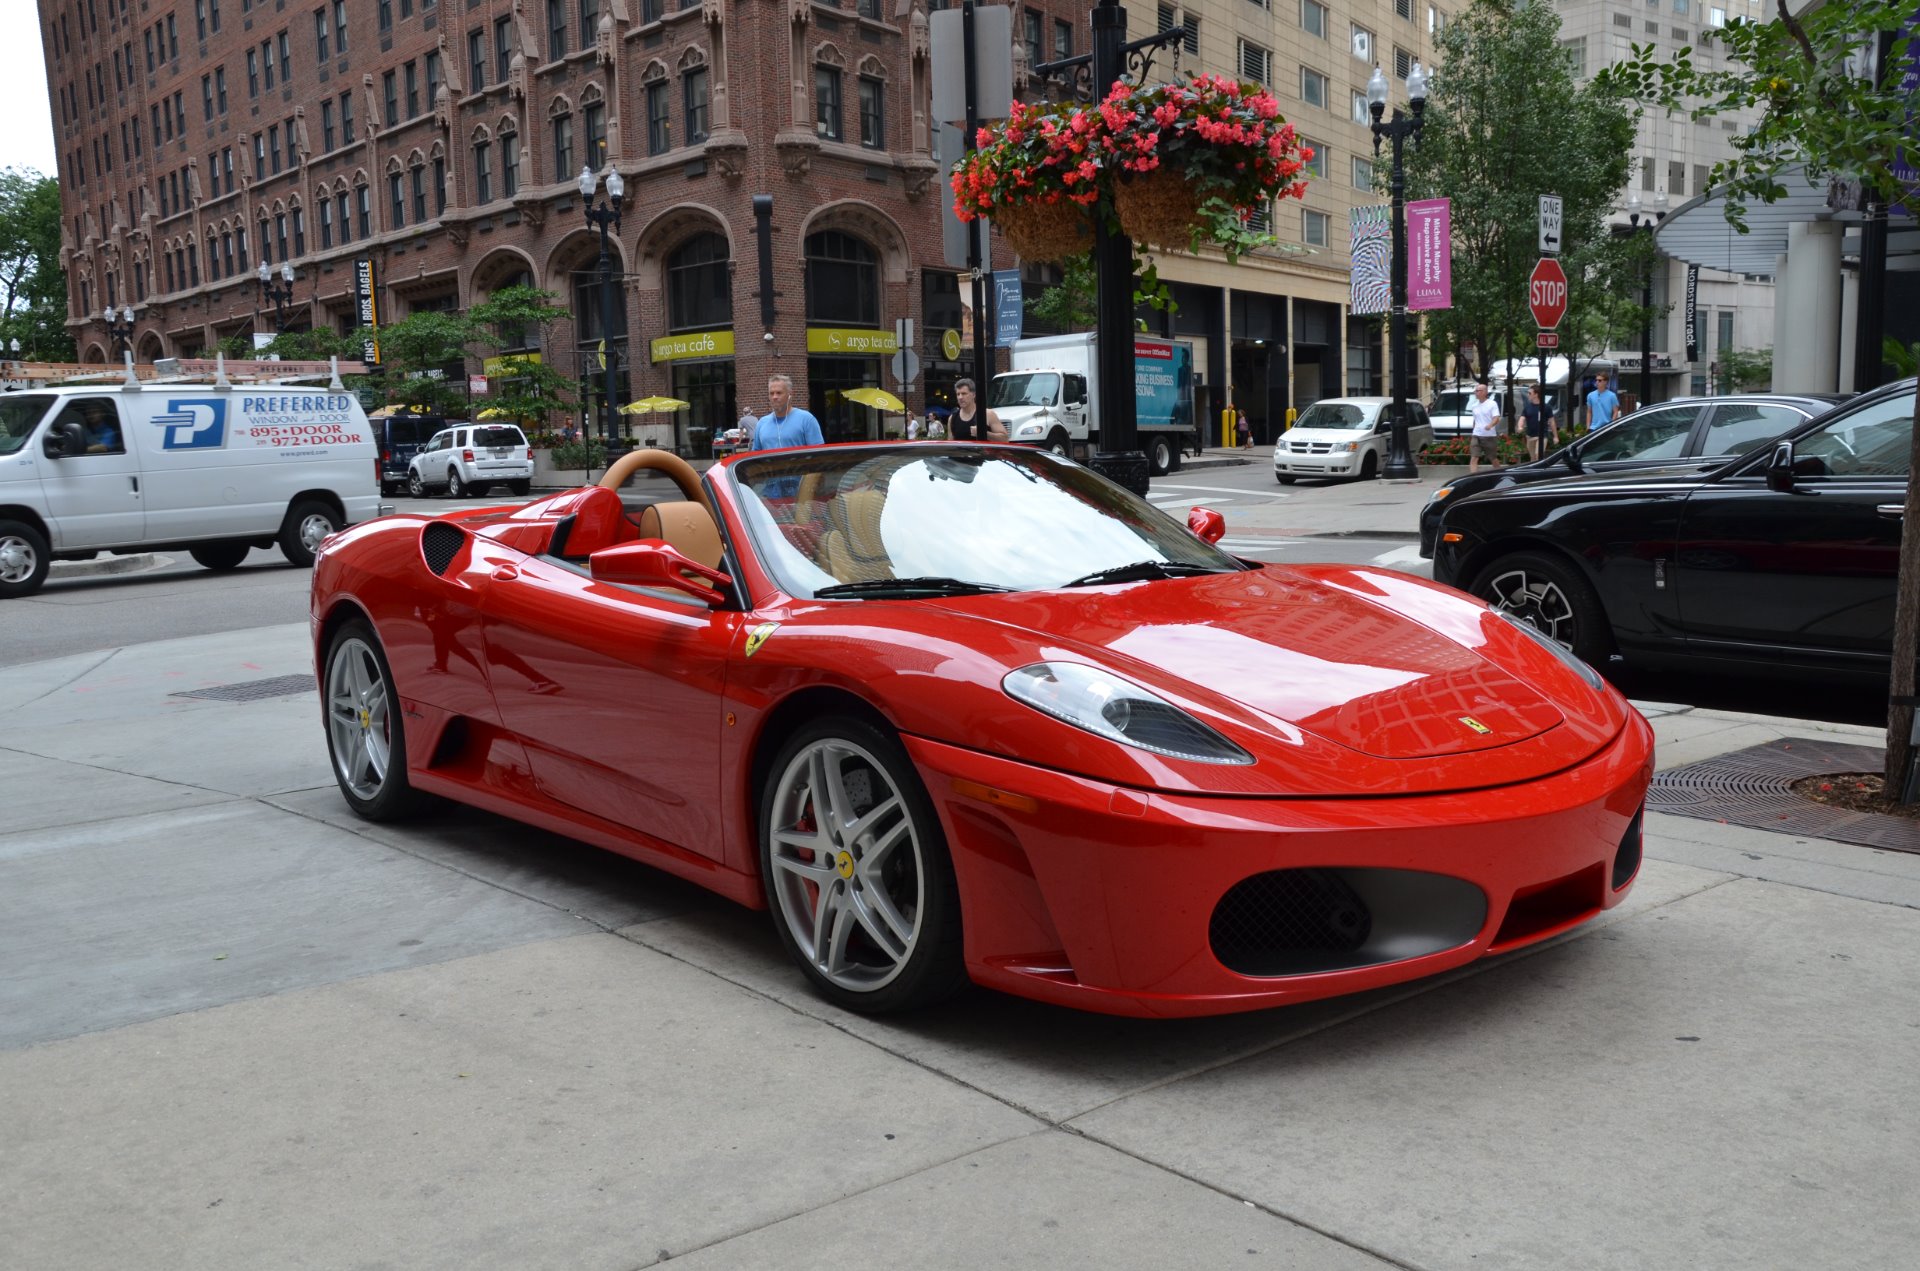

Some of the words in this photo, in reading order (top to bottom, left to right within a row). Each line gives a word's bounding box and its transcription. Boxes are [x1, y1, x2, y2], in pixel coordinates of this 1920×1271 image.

[1543, 200, 1559, 215] ONE
[1543, 216, 1559, 231] WAY
[1433, 218, 1441, 250] Michelle
[1433, 251, 1441, 282] Murphy:
[358, 261, 371, 295] BAGELS
[1416, 289, 1442, 297] LUMA
[1532, 280, 1565, 307] STOP
[1686, 268, 1696, 322] NORDSTROM
[674, 342, 686, 353] tea
[689, 334, 715, 351] café
[846, 336, 870, 351] argo
[871, 336, 882, 348] tea
[1539, 336, 1547, 344] ALL
[1686, 324, 1696, 346] rack
[243, 395, 351, 414] PREFERRED
[249, 415, 298, 424] WINDOW
[319, 413, 350, 422] DOOR
